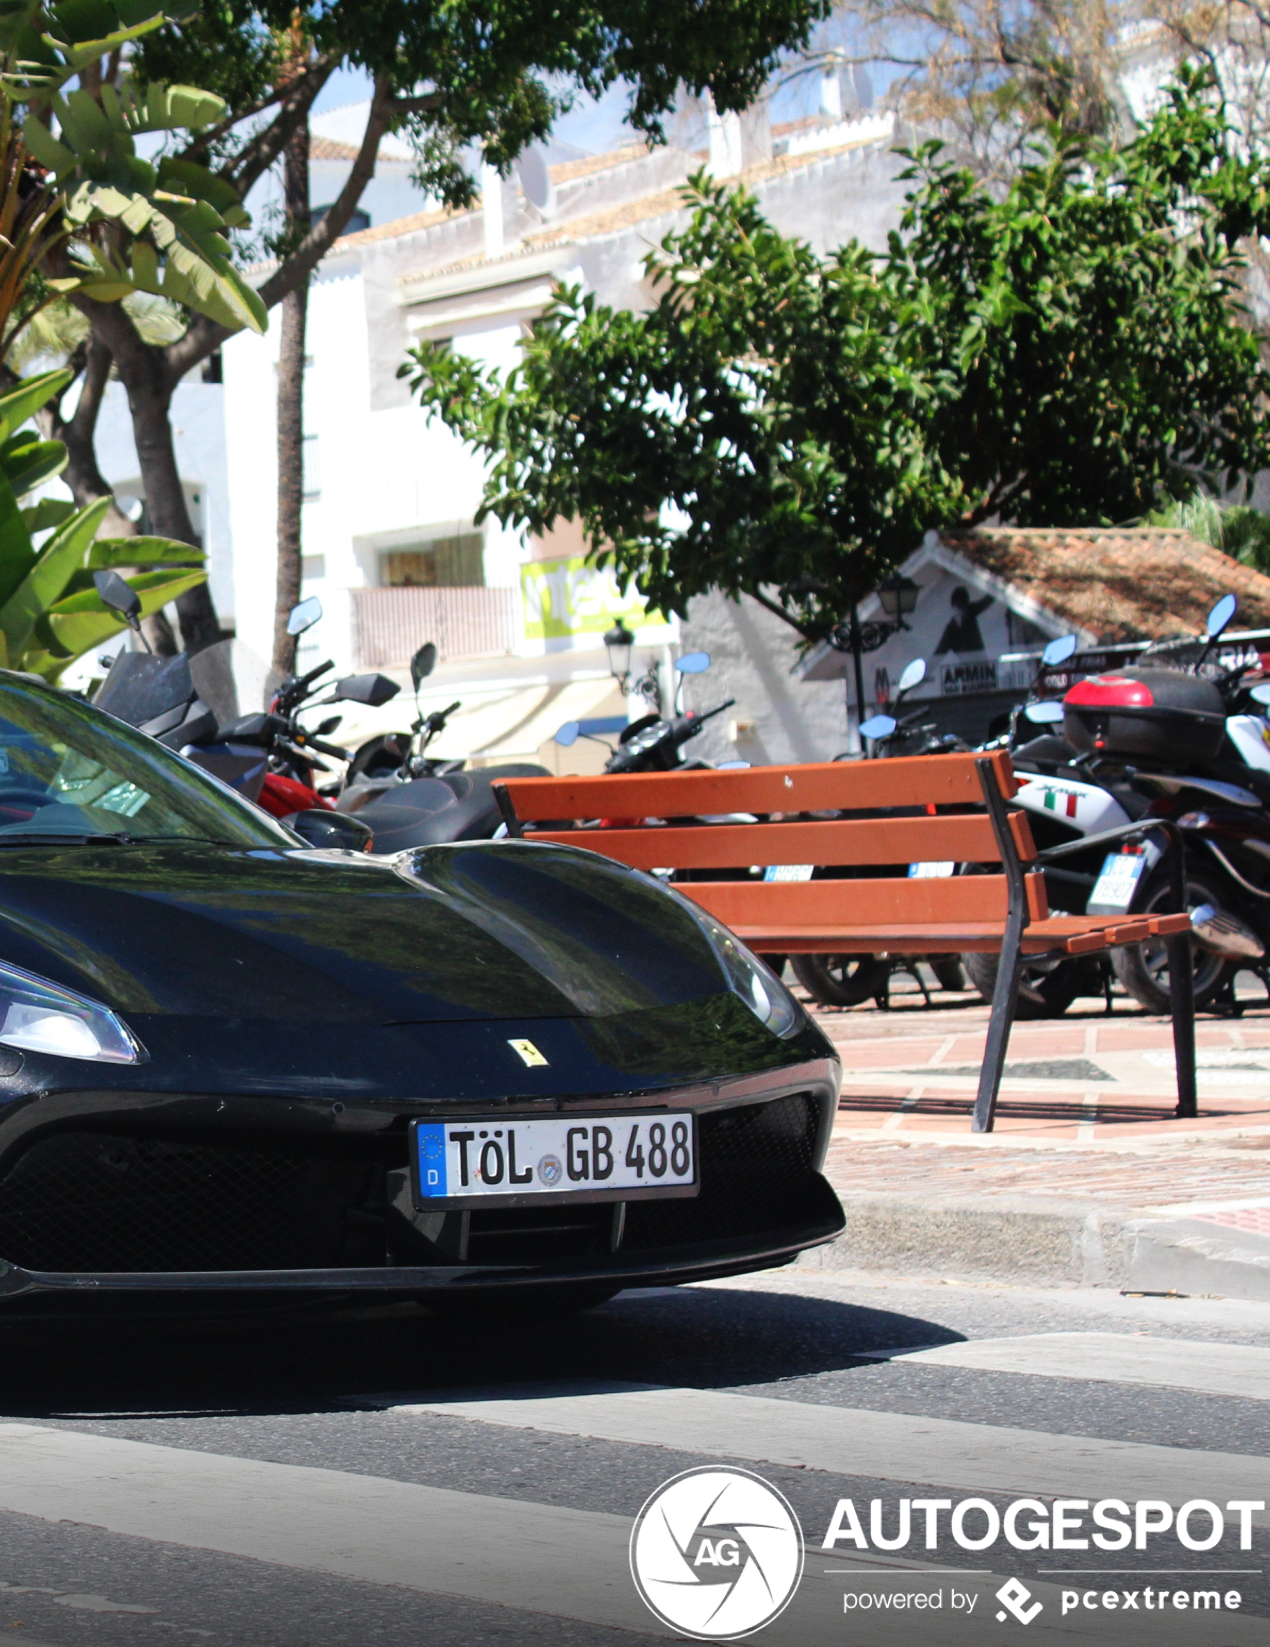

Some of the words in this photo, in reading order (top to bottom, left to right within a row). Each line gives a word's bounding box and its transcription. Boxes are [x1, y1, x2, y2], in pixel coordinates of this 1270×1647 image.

[449, 1129, 533, 1187] TÖL
[566, 1125, 614, 1181] GB
[625, 1120, 691, 1179] 488
[427, 1169, 439, 1185] D
